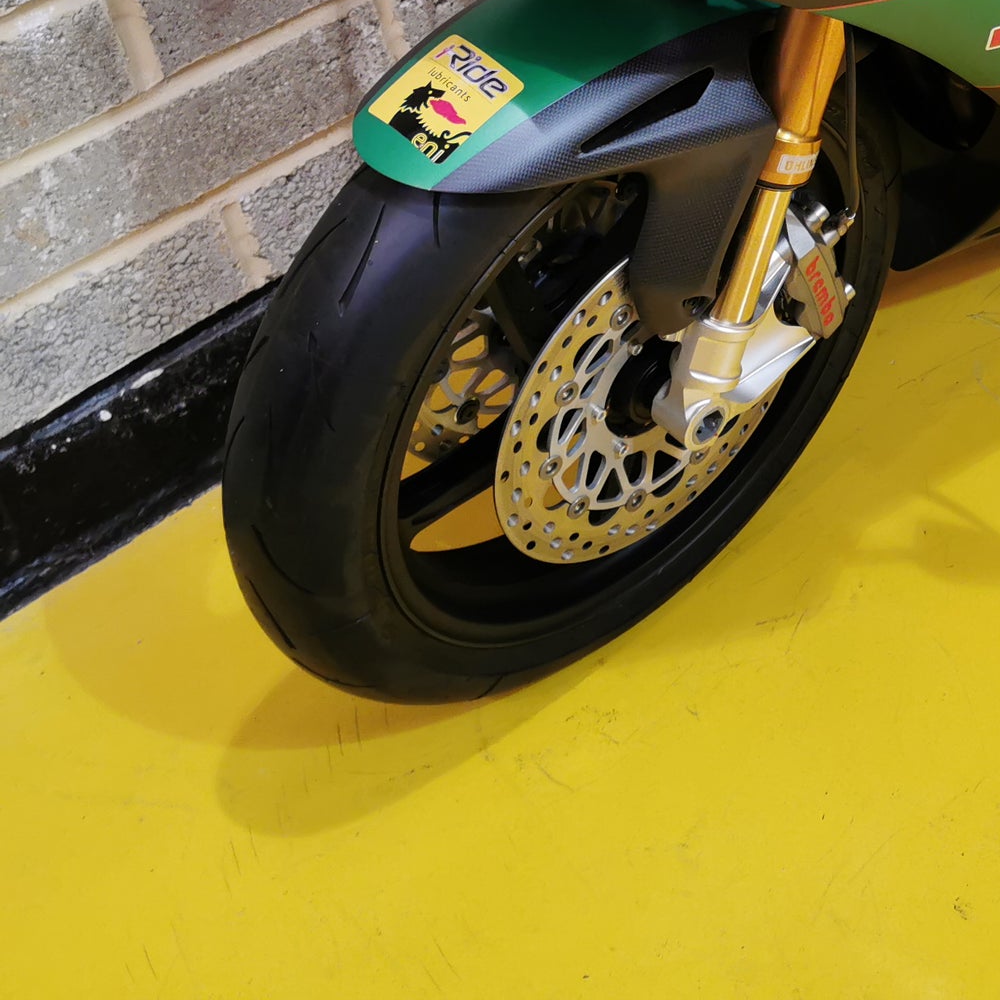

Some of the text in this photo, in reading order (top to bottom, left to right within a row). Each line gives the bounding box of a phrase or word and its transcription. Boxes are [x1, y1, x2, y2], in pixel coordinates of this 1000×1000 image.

[427, 67, 472, 103] lubricants
[434, 44, 509, 100] iRide
[412, 132, 450, 163] eni
[805, 255, 836, 327] brembo
